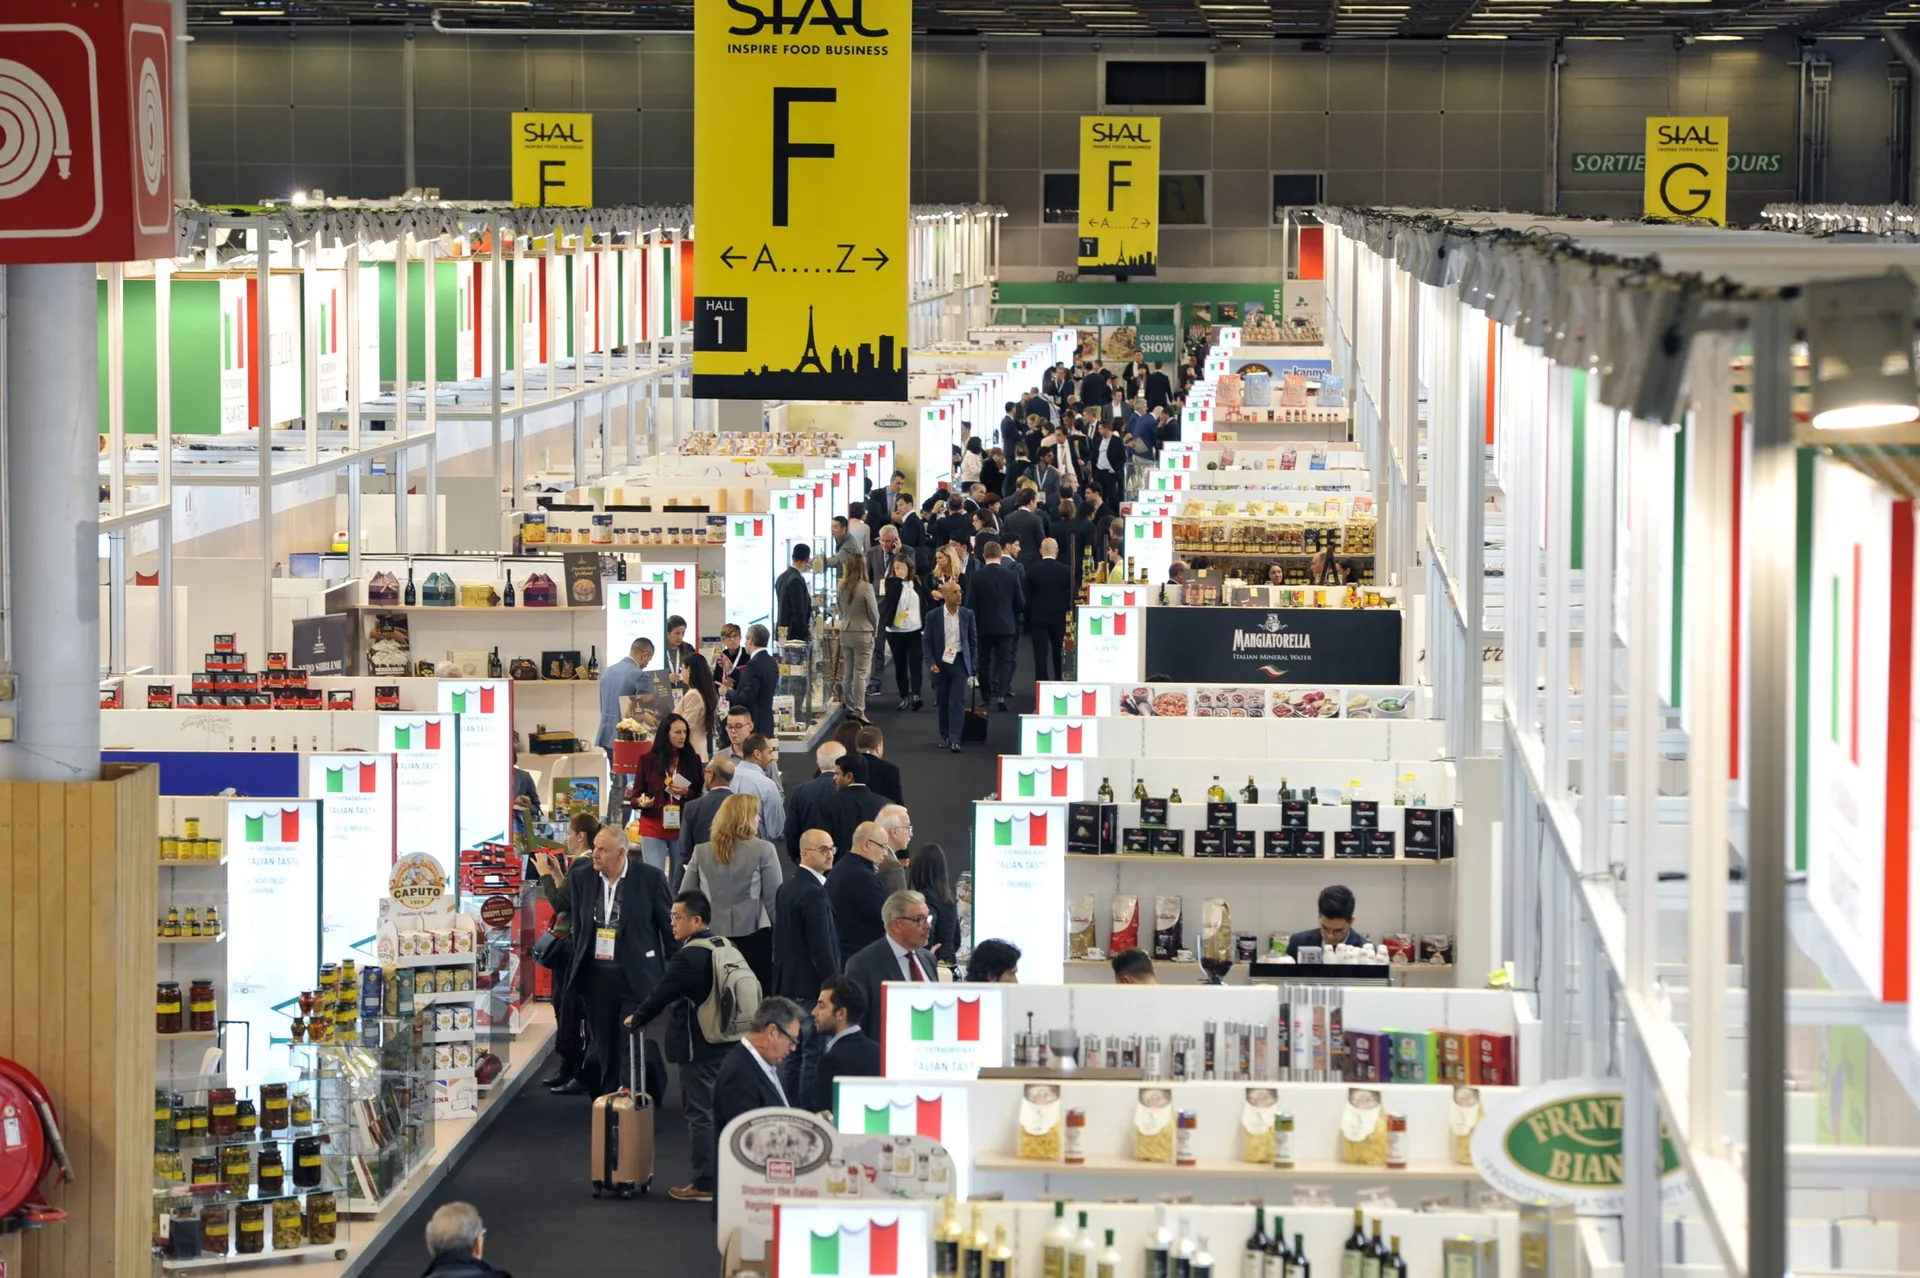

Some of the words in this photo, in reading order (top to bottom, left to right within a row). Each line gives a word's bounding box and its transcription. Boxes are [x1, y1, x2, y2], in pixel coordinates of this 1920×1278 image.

[726, 0, 890, 38] SIAL
[728, 44, 778, 54] INSPIRE
[783, 44, 820, 55] FOOD
[825, 45, 889, 56] BUSINESS
[524, 122, 584, 142] SIAL
[1092, 123, 1152, 143] SIAL
[1658, 125, 1719, 145] SIAL
[772, 87, 837, 227] F
[1574, 155, 1646, 171] SORTIE
[1727, 154, 1781, 171] OURS
[539, 160, 566, 207] F
[1107, 160, 1132, 212] F
[1659, 162, 1712, 216] G
[1085, 244, 1091, 255] 1
[706, 300, 735, 311] HALL
[713, 316, 724, 345] 1
[1140, 334, 1174, 342] COOKING
[1140, 342, 1174, 353] SHOW
[1232, 629, 1311, 651] MANGIATORELLA
[393, 887, 441, 899] CAPUTO
[1526, 1100, 1625, 1145] FRANT
[1546, 1148, 1625, 1182] BIAN
